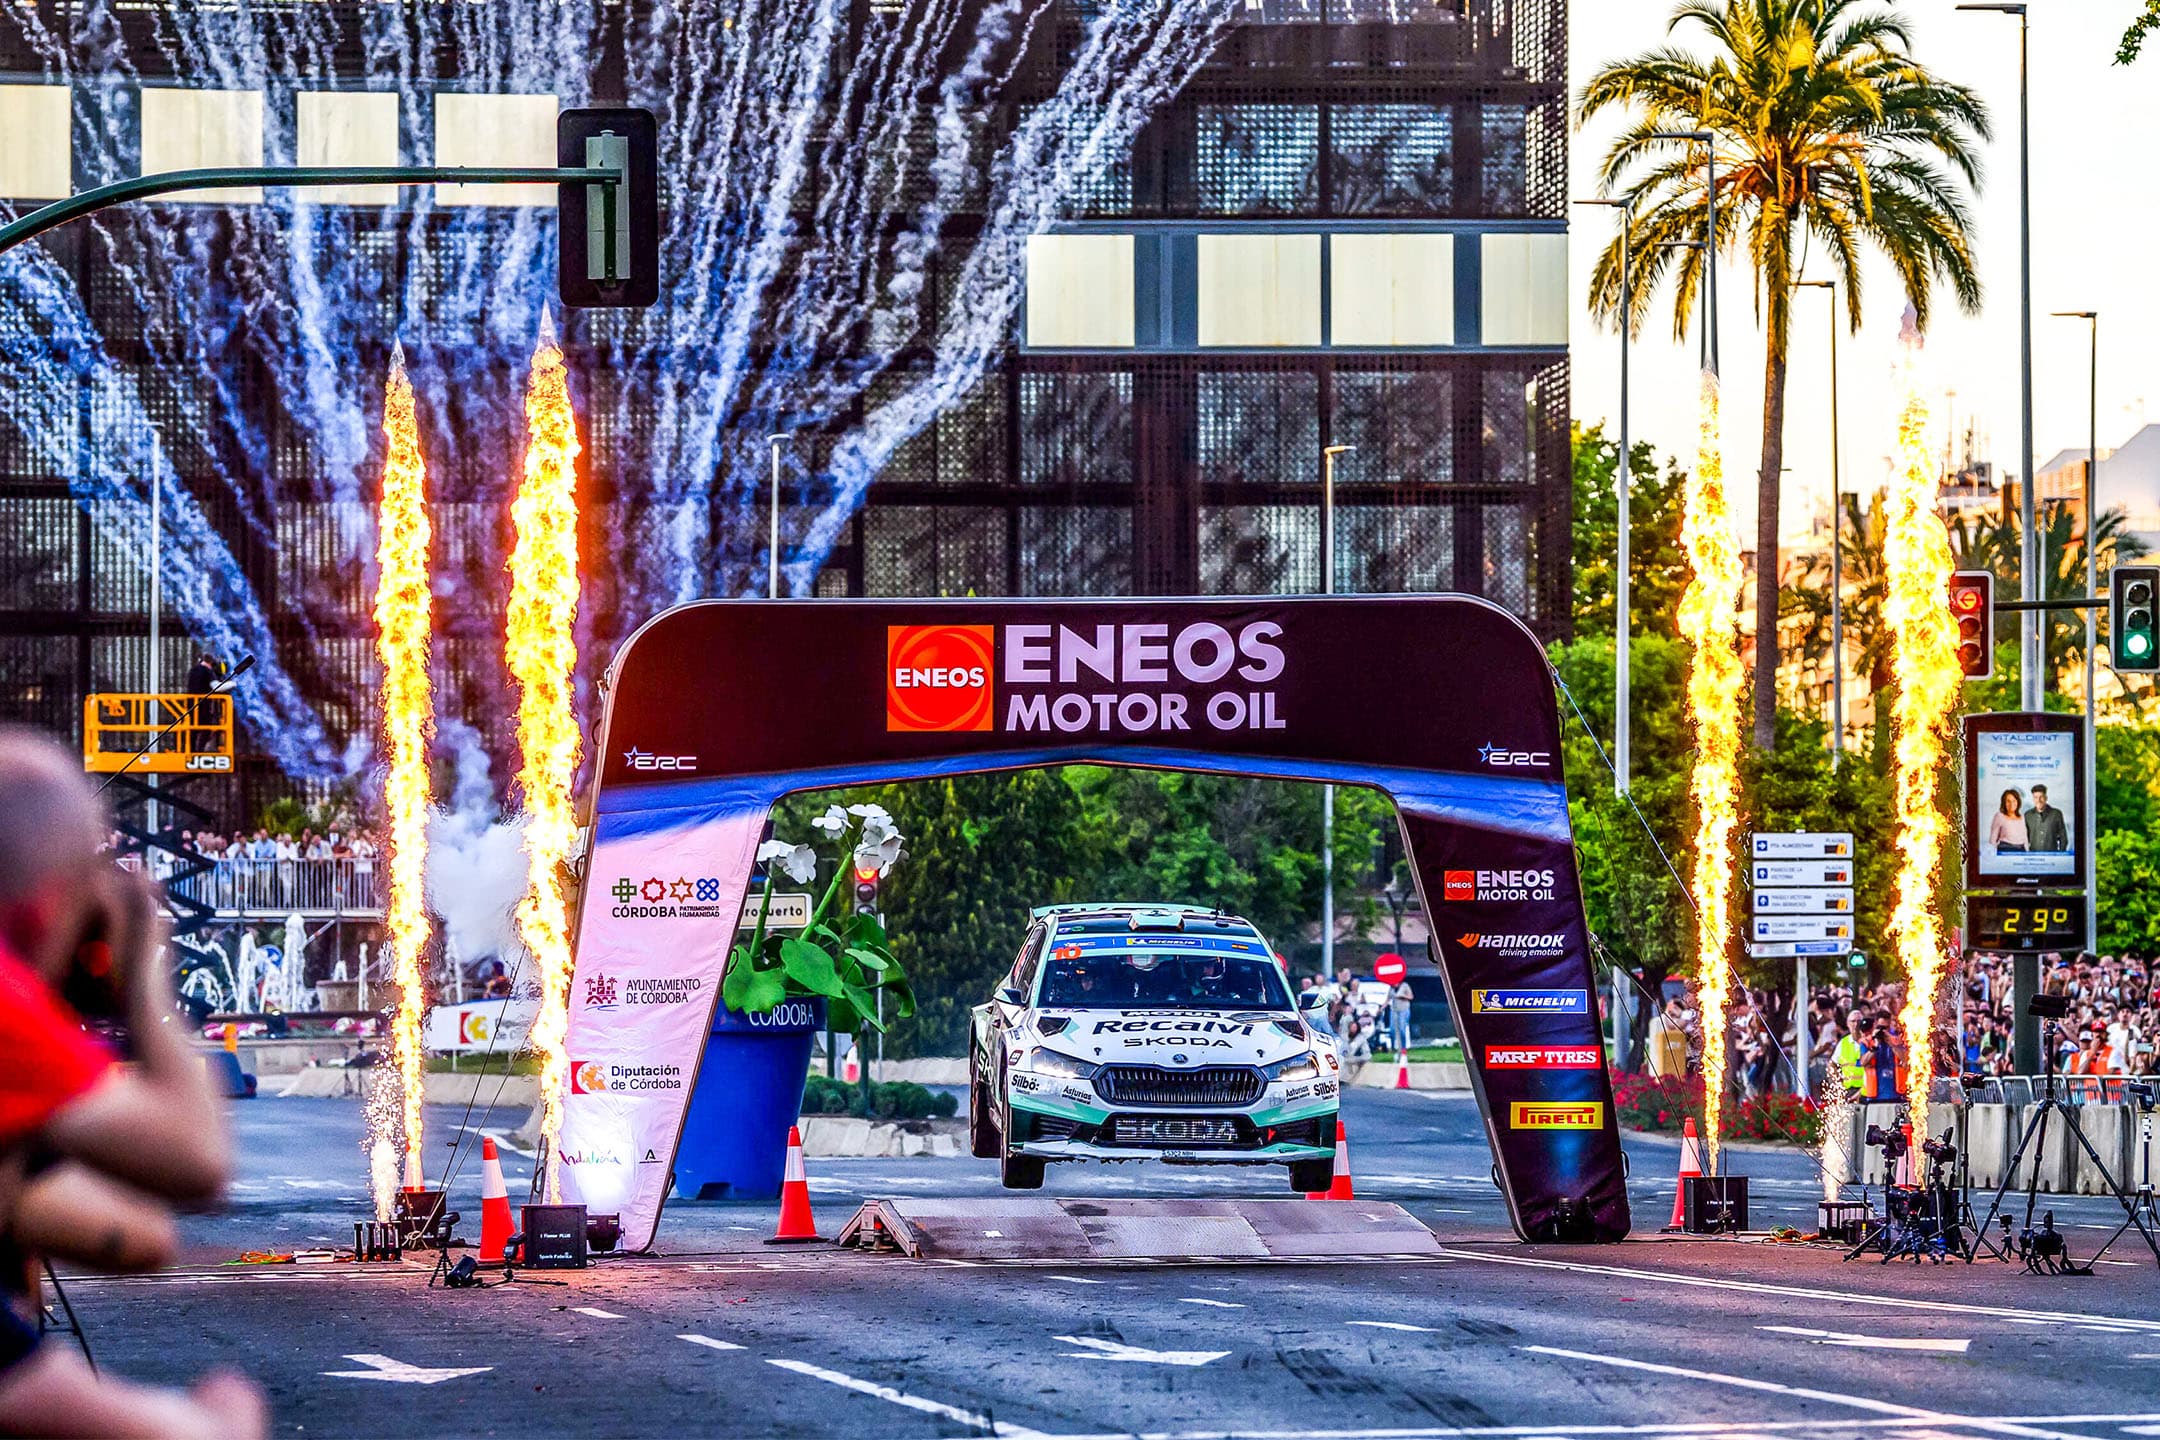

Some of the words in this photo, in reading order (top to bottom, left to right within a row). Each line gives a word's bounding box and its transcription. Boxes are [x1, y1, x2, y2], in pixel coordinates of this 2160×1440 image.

[1005, 621, 1286, 683] ENEOS
[895, 667, 985, 687] ENEOS
[1005, 692, 1191, 732] MOTOR
[1206, 691, 1286, 730] OIL
[186, 755, 231, 770] JCB
[634, 755, 697, 770] ERC
[1489, 752, 1551, 766] ERC
[1476, 869, 1555, 888] ENEOS
[1477, 889, 1528, 900] MOTOR
[1532, 889, 1555, 900] OIL
[612, 905, 677, 918] CÓRDOBA
[745, 905, 803, 917] rouerto
[1055, 946, 1082, 960] 10
[1499, 949, 1527, 957] driving
[626, 978, 701, 991] AYUNTAMIENTO
[626, 993, 638, 1004] DE
[640, 990, 689, 1004] CÓRDOBA
[1504, 997, 1577, 1006] MICHELIN
[1092, 1020, 1255, 1037] Recalvi
[1489, 1051, 1542, 1064] MRF
[1544, 1051, 1597, 1064] TYRES
[611, 1065, 680, 1079] Diputación
[611, 1079, 626, 1090] de
[629, 1079, 681, 1090] Córdoba
[1520, 1107, 1595, 1124] PIRELLI
